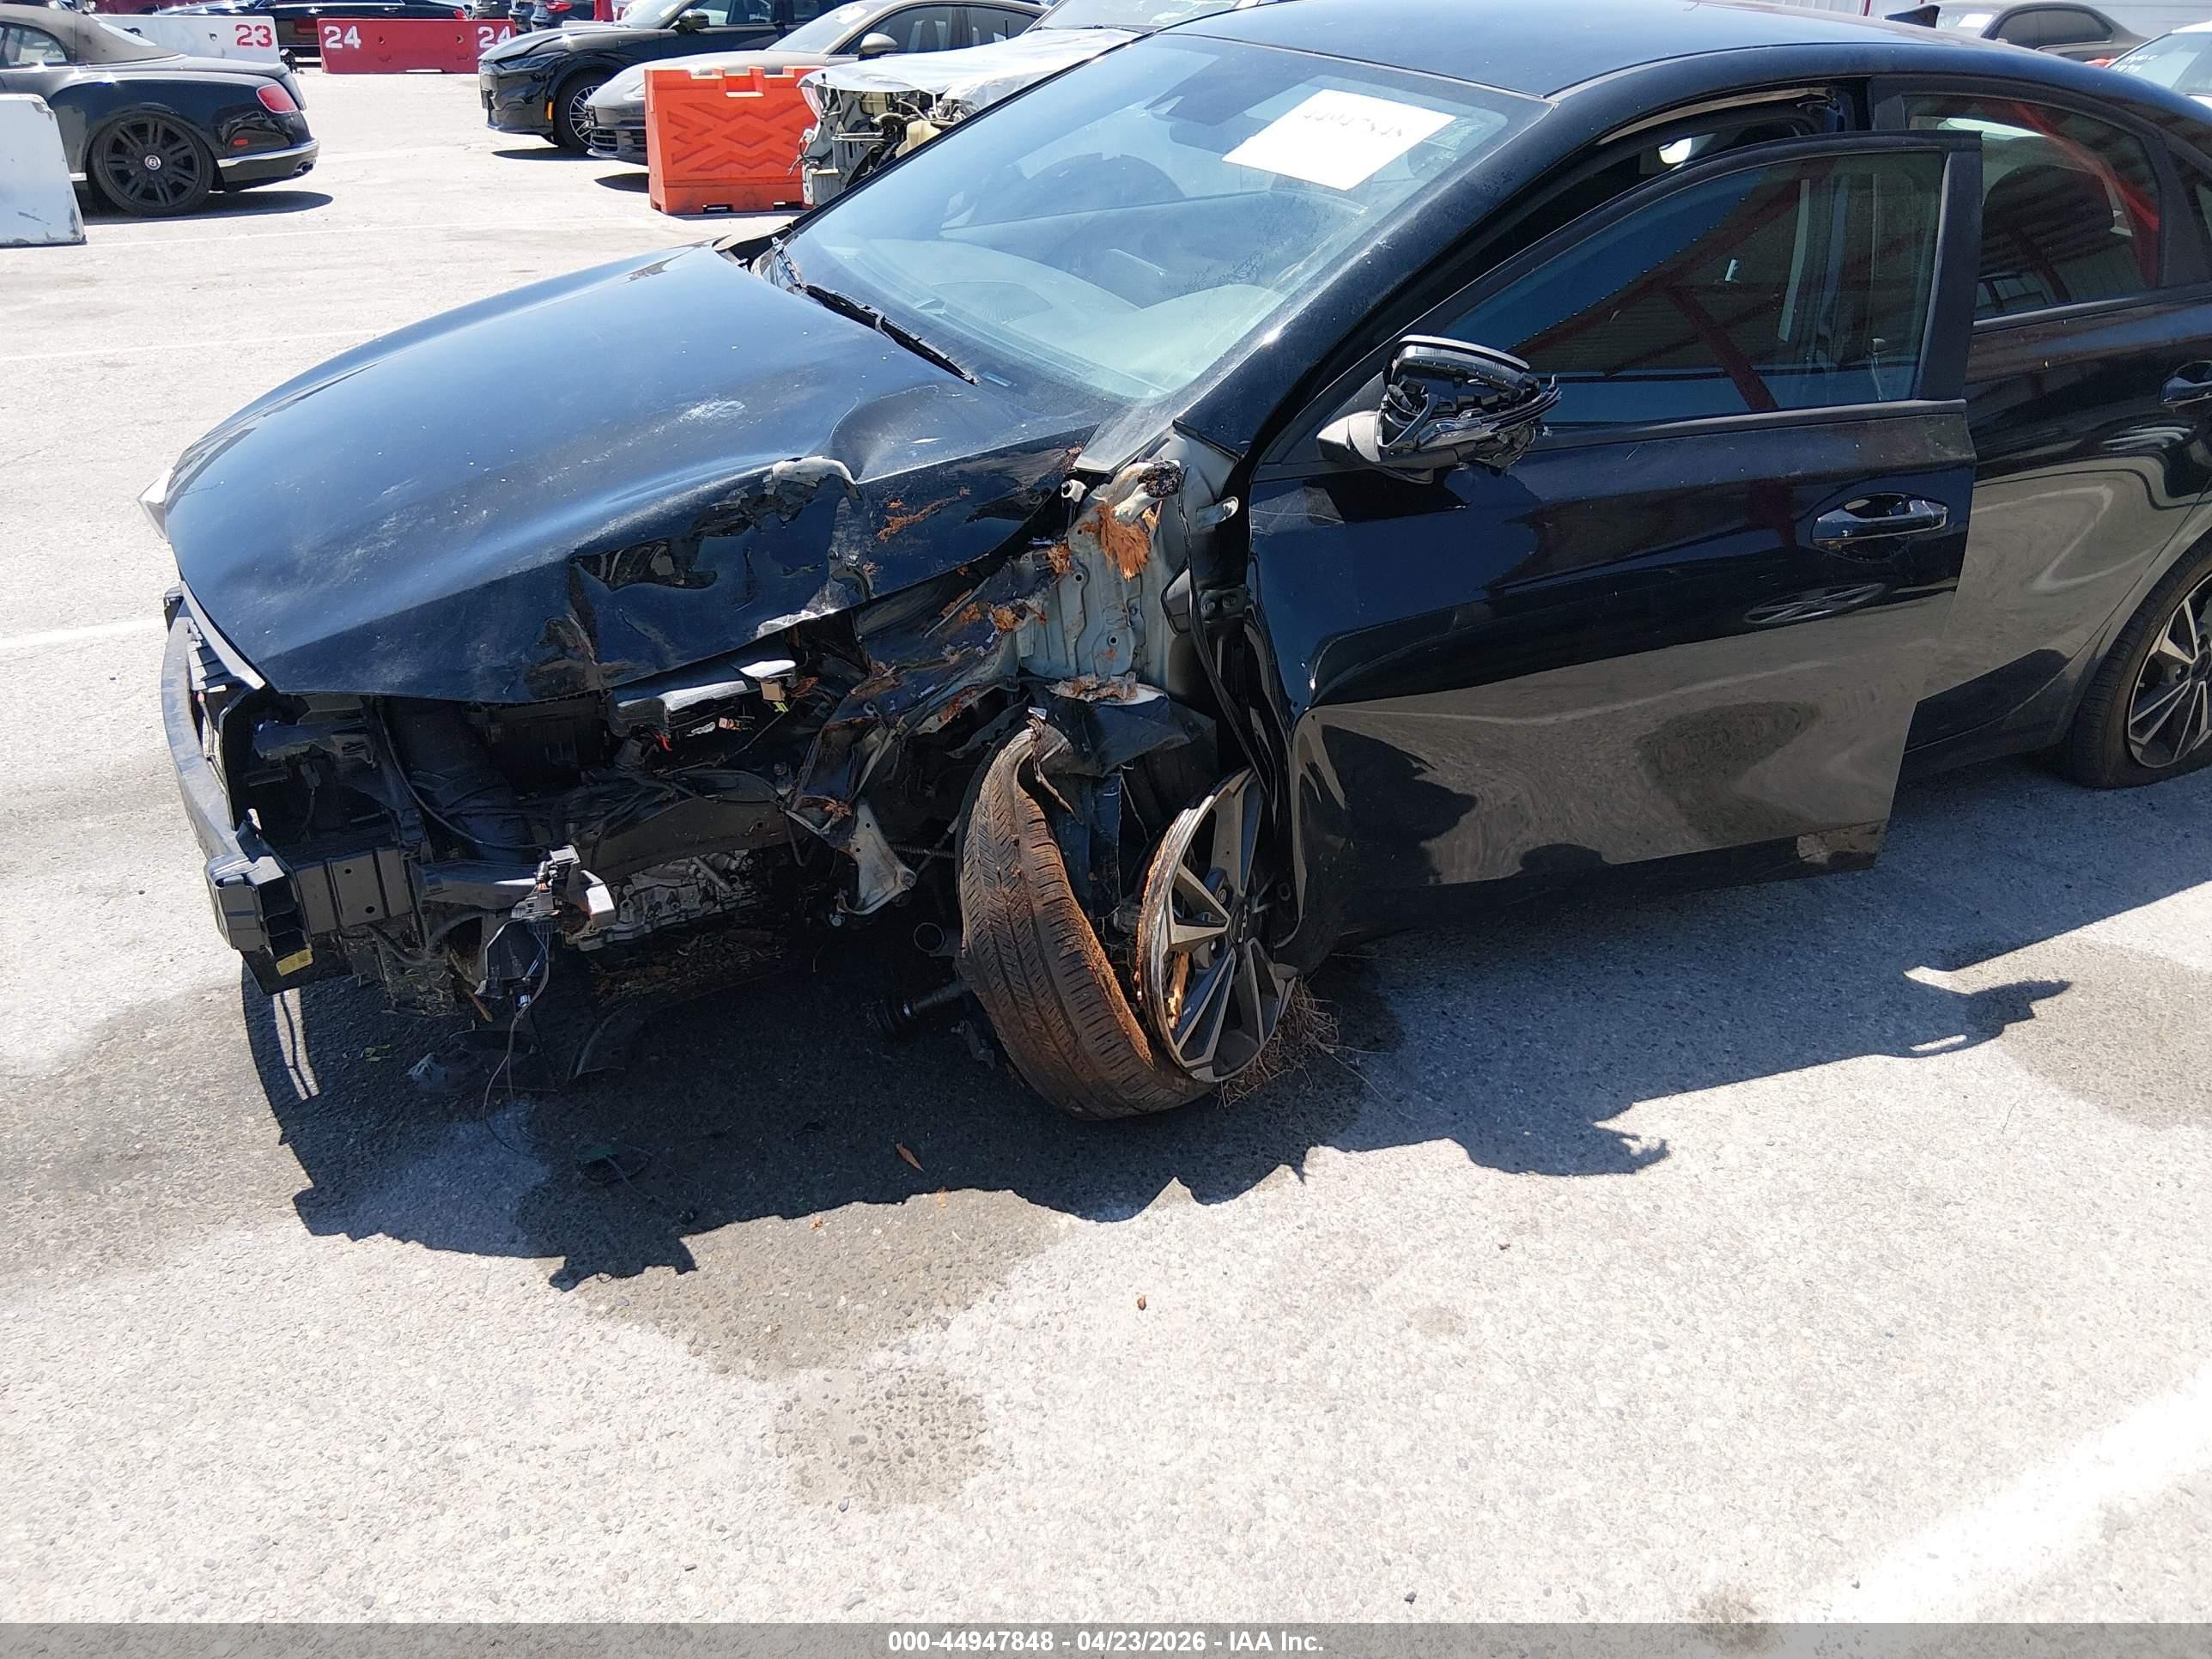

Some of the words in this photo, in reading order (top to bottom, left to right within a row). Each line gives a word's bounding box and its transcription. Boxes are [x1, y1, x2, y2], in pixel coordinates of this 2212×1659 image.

[235, 24, 272, 47] 23
[324, 26, 362, 49] 24
[477, 26, 511, 49] 24
